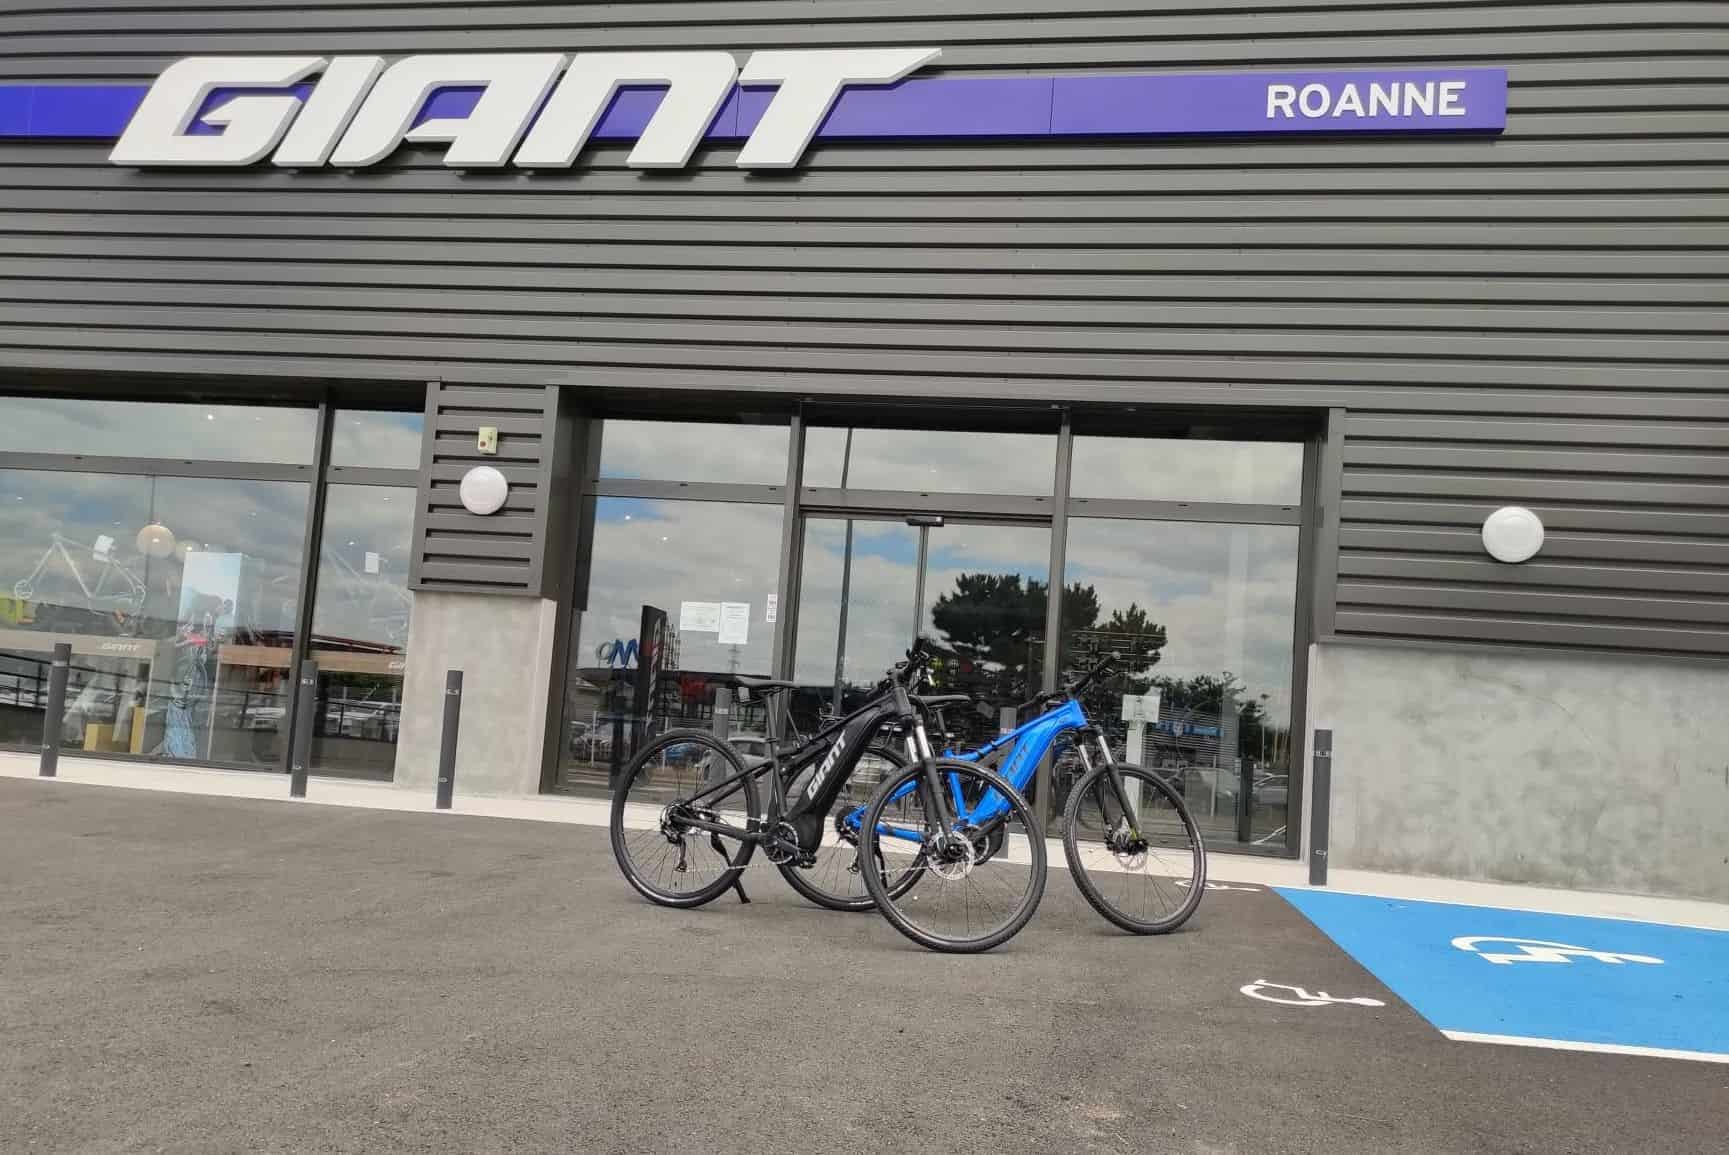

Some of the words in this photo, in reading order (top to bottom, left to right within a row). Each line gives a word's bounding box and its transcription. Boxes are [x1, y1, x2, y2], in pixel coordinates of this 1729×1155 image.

[108, 47, 943, 168] GIANT
[1266, 81, 1466, 118] ROANNE
[807, 729, 846, 801] GIANT
